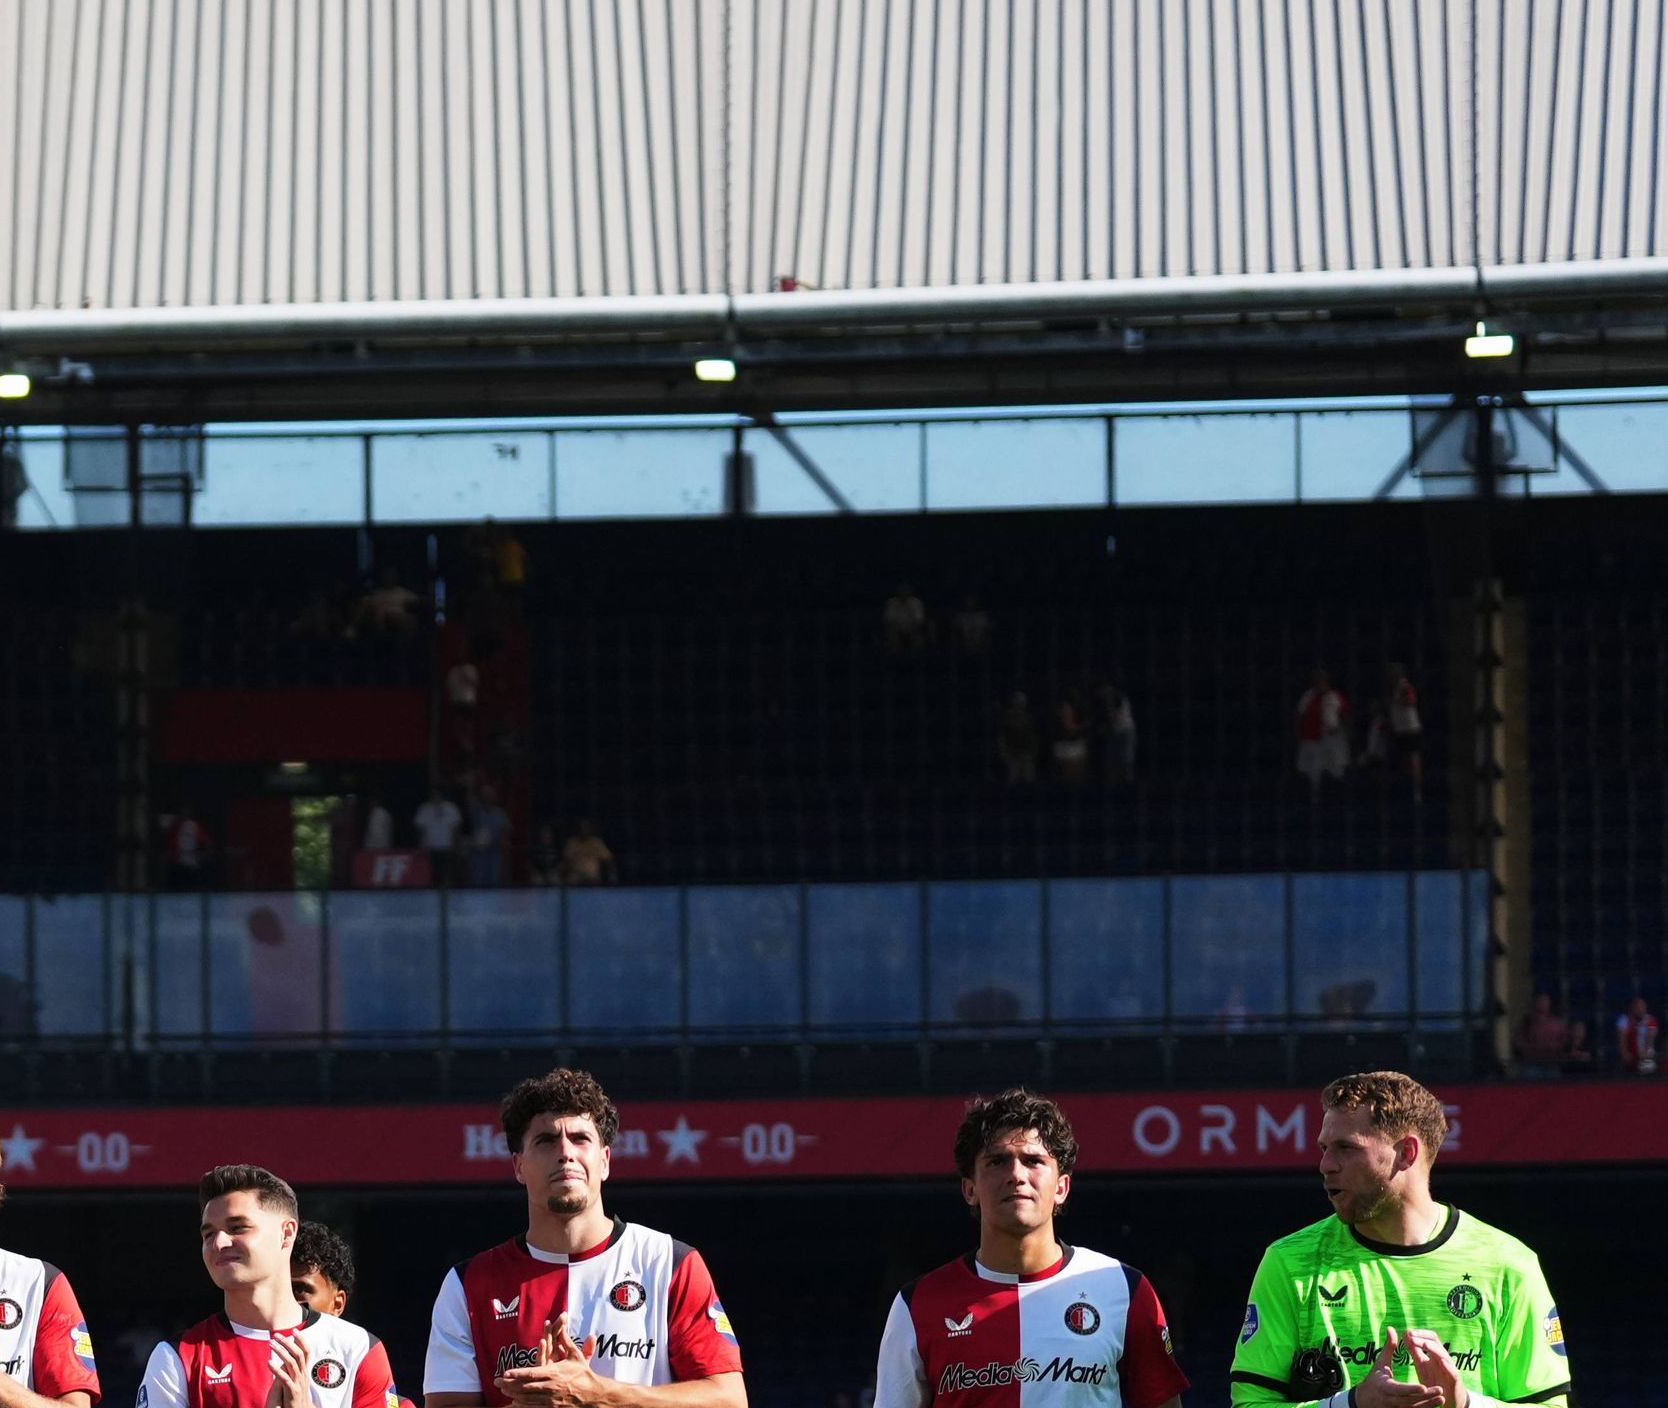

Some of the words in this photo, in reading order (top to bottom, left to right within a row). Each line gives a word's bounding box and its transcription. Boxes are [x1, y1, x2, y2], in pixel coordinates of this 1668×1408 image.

[596, 1333, 655, 1360] Markt
[938, 1362, 1014, 1395] Media
[1036, 1356, 1107, 1386] Markt
